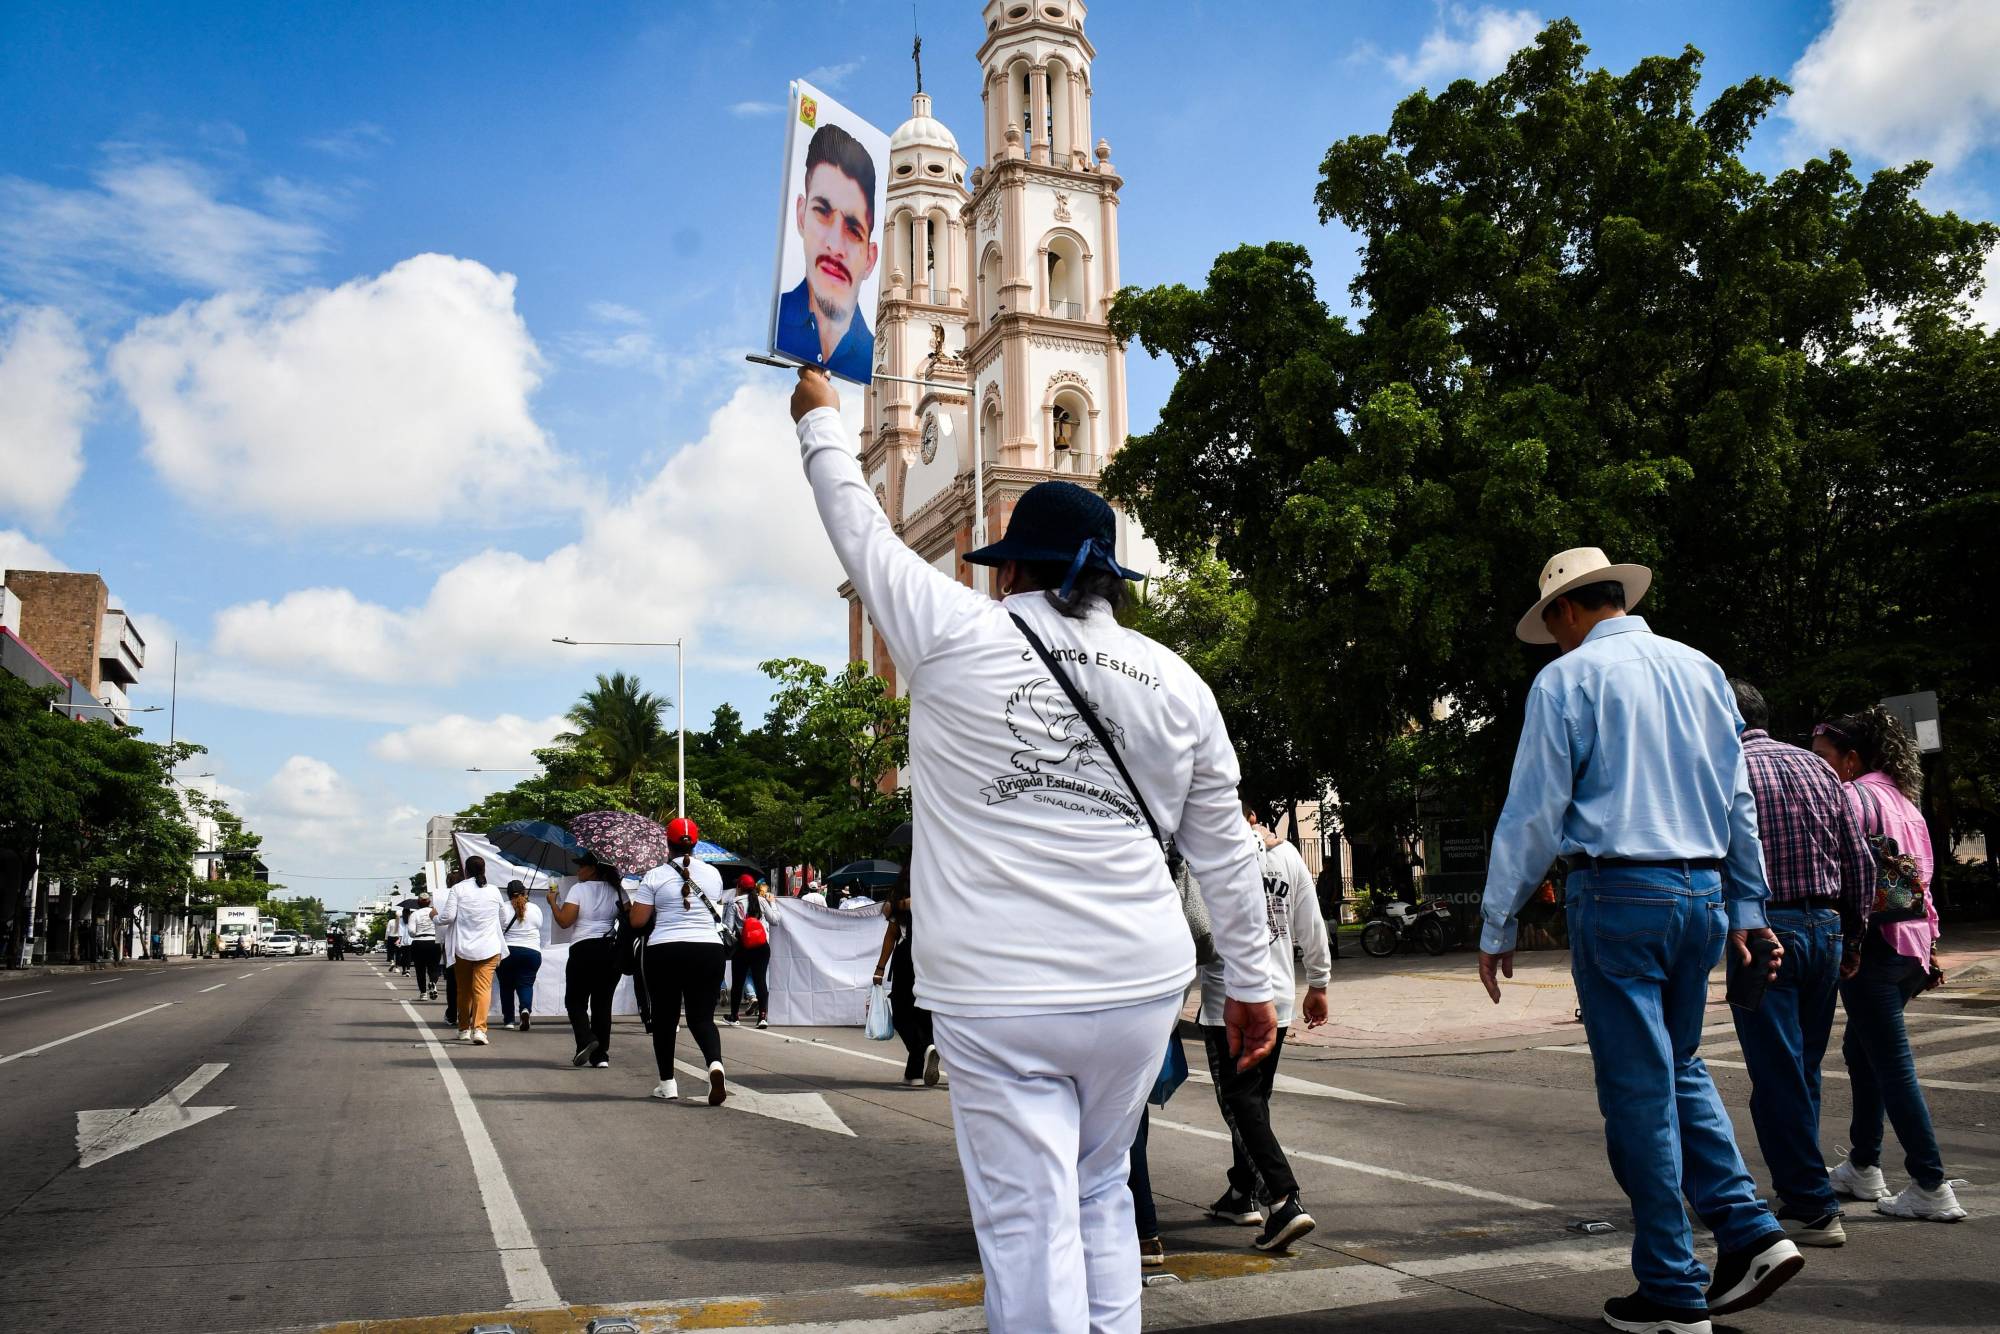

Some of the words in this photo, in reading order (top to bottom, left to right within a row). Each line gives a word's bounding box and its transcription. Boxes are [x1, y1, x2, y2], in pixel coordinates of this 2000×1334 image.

[1096, 651, 1160, 690] Están?
[997, 775, 1043, 794] Brigada
[1046, 775, 1086, 793] Estatal
[1088, 786, 1099, 797] de
[1033, 794, 1089, 815] SINALOA,
[1090, 807, 1113, 819] MEX.
